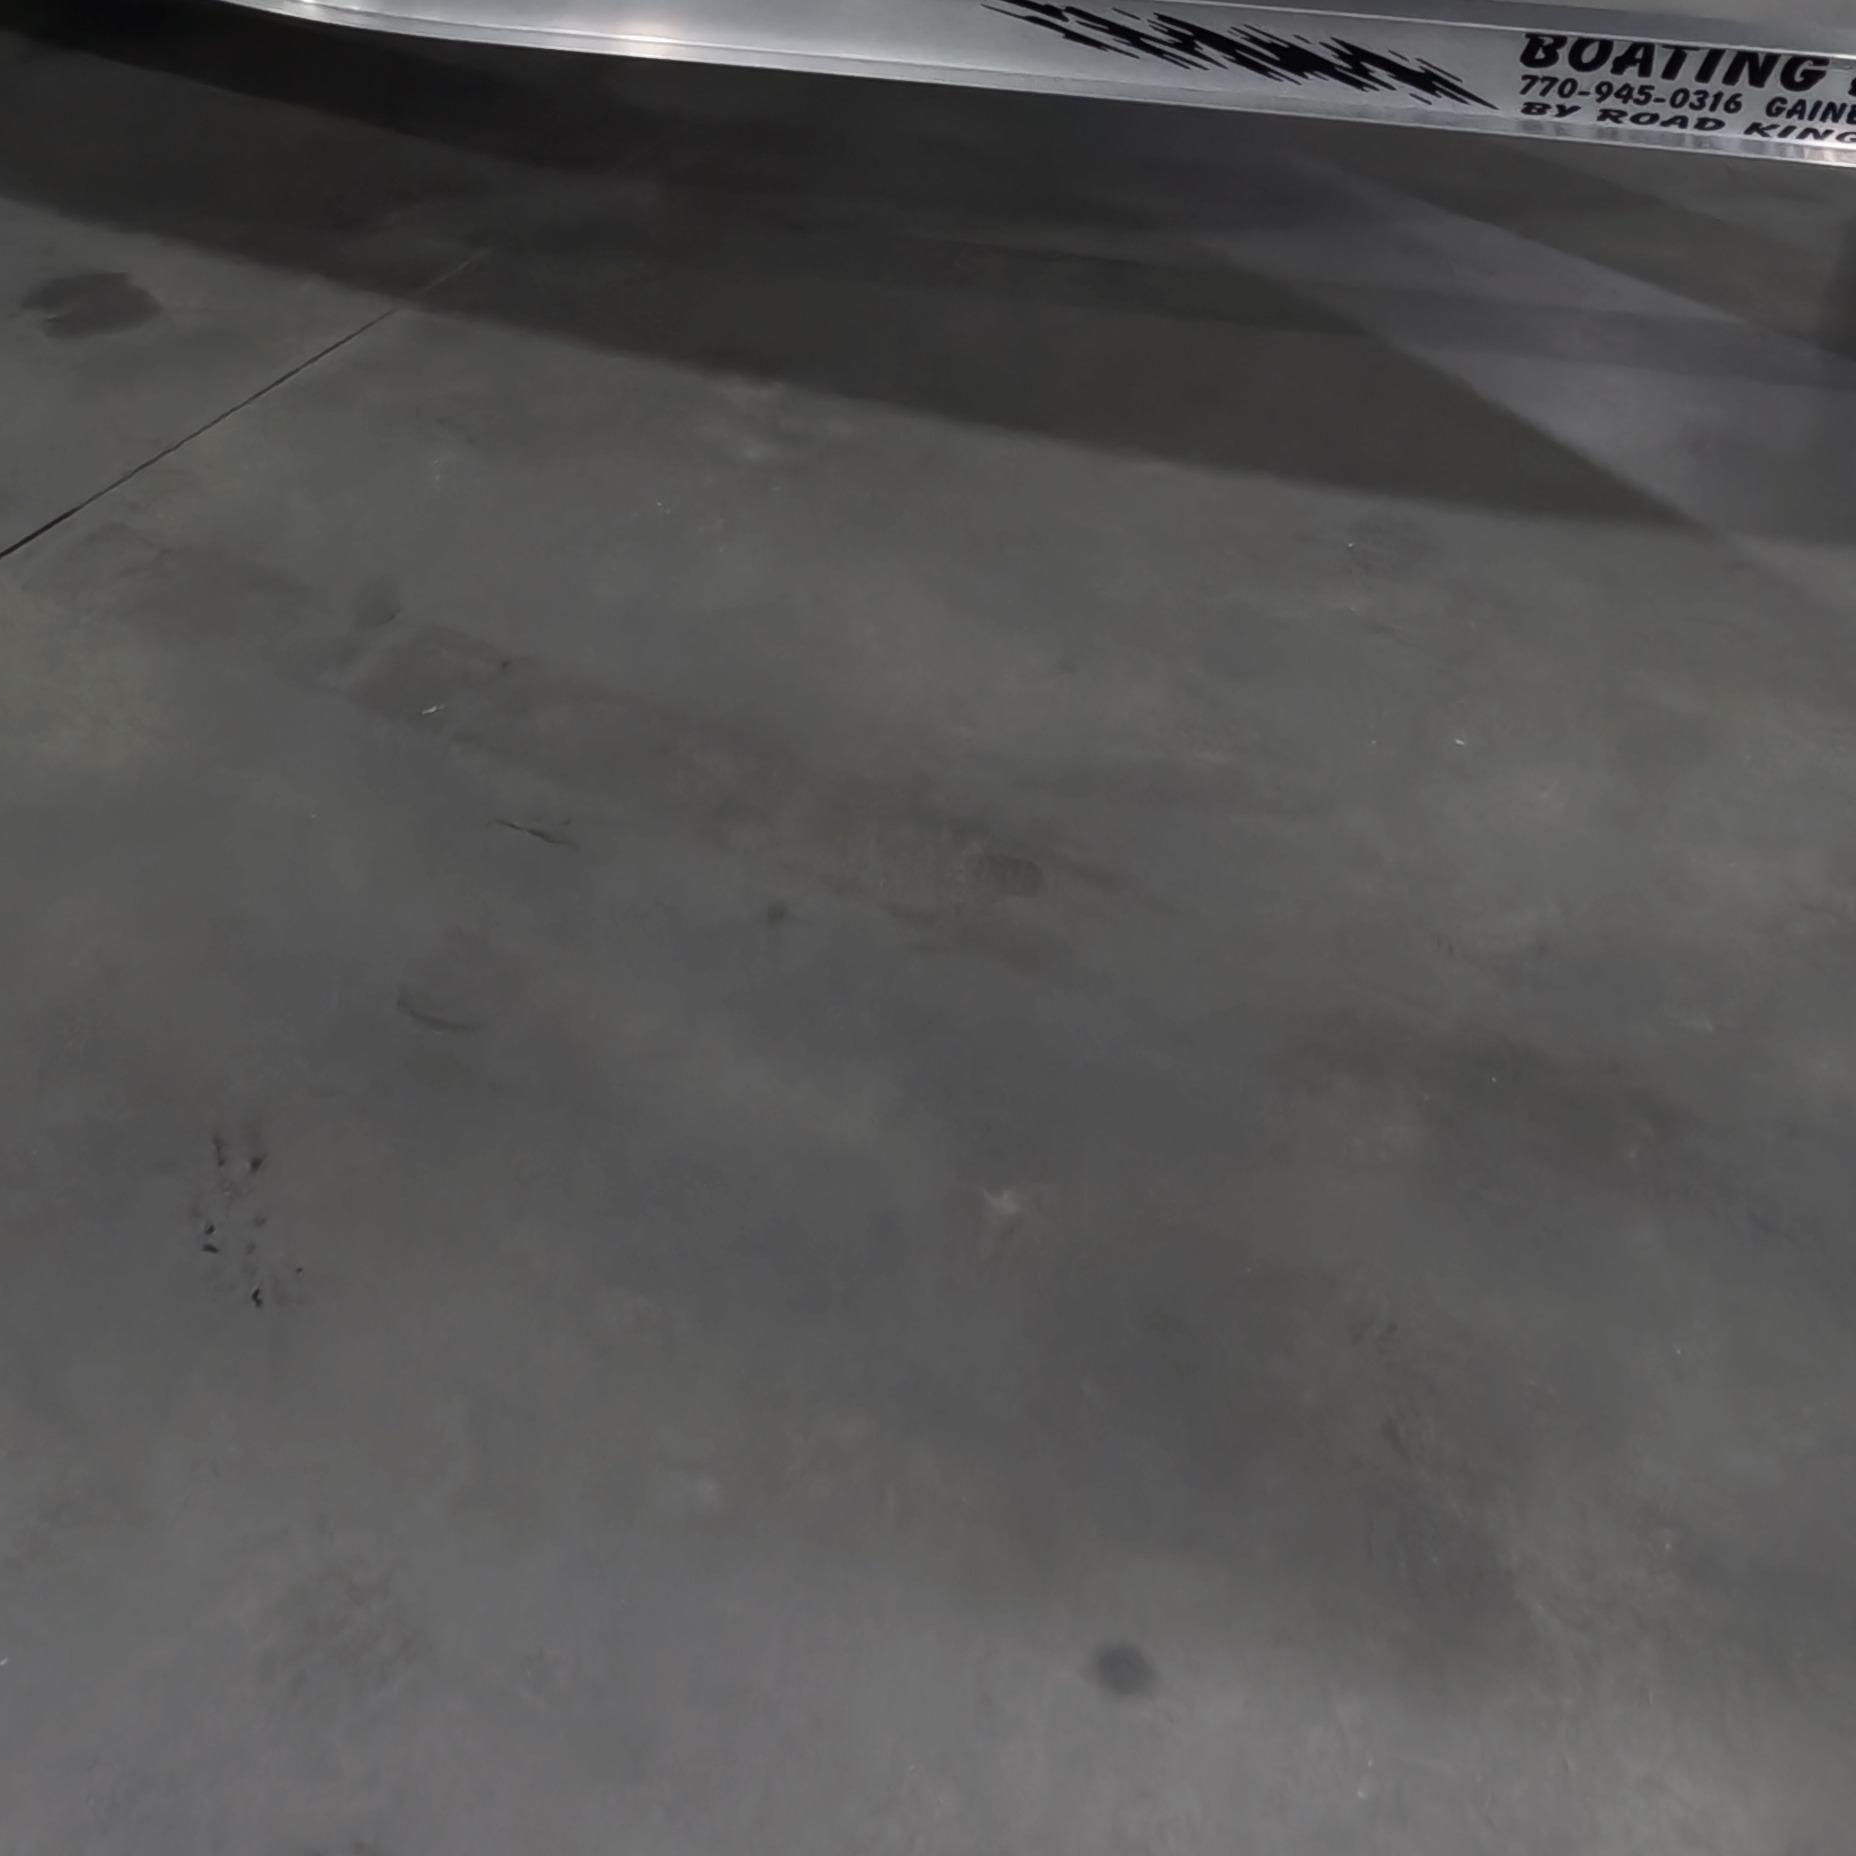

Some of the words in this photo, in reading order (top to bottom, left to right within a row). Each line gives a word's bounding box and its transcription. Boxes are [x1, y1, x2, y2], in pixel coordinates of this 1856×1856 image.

[1519, 32, 1830, 93] BOATING
[1518, 75, 1743, 115] 770-945-0316
[1520, 101, 1582, 118] BY
[1596, 108, 1726, 132] ROAD
